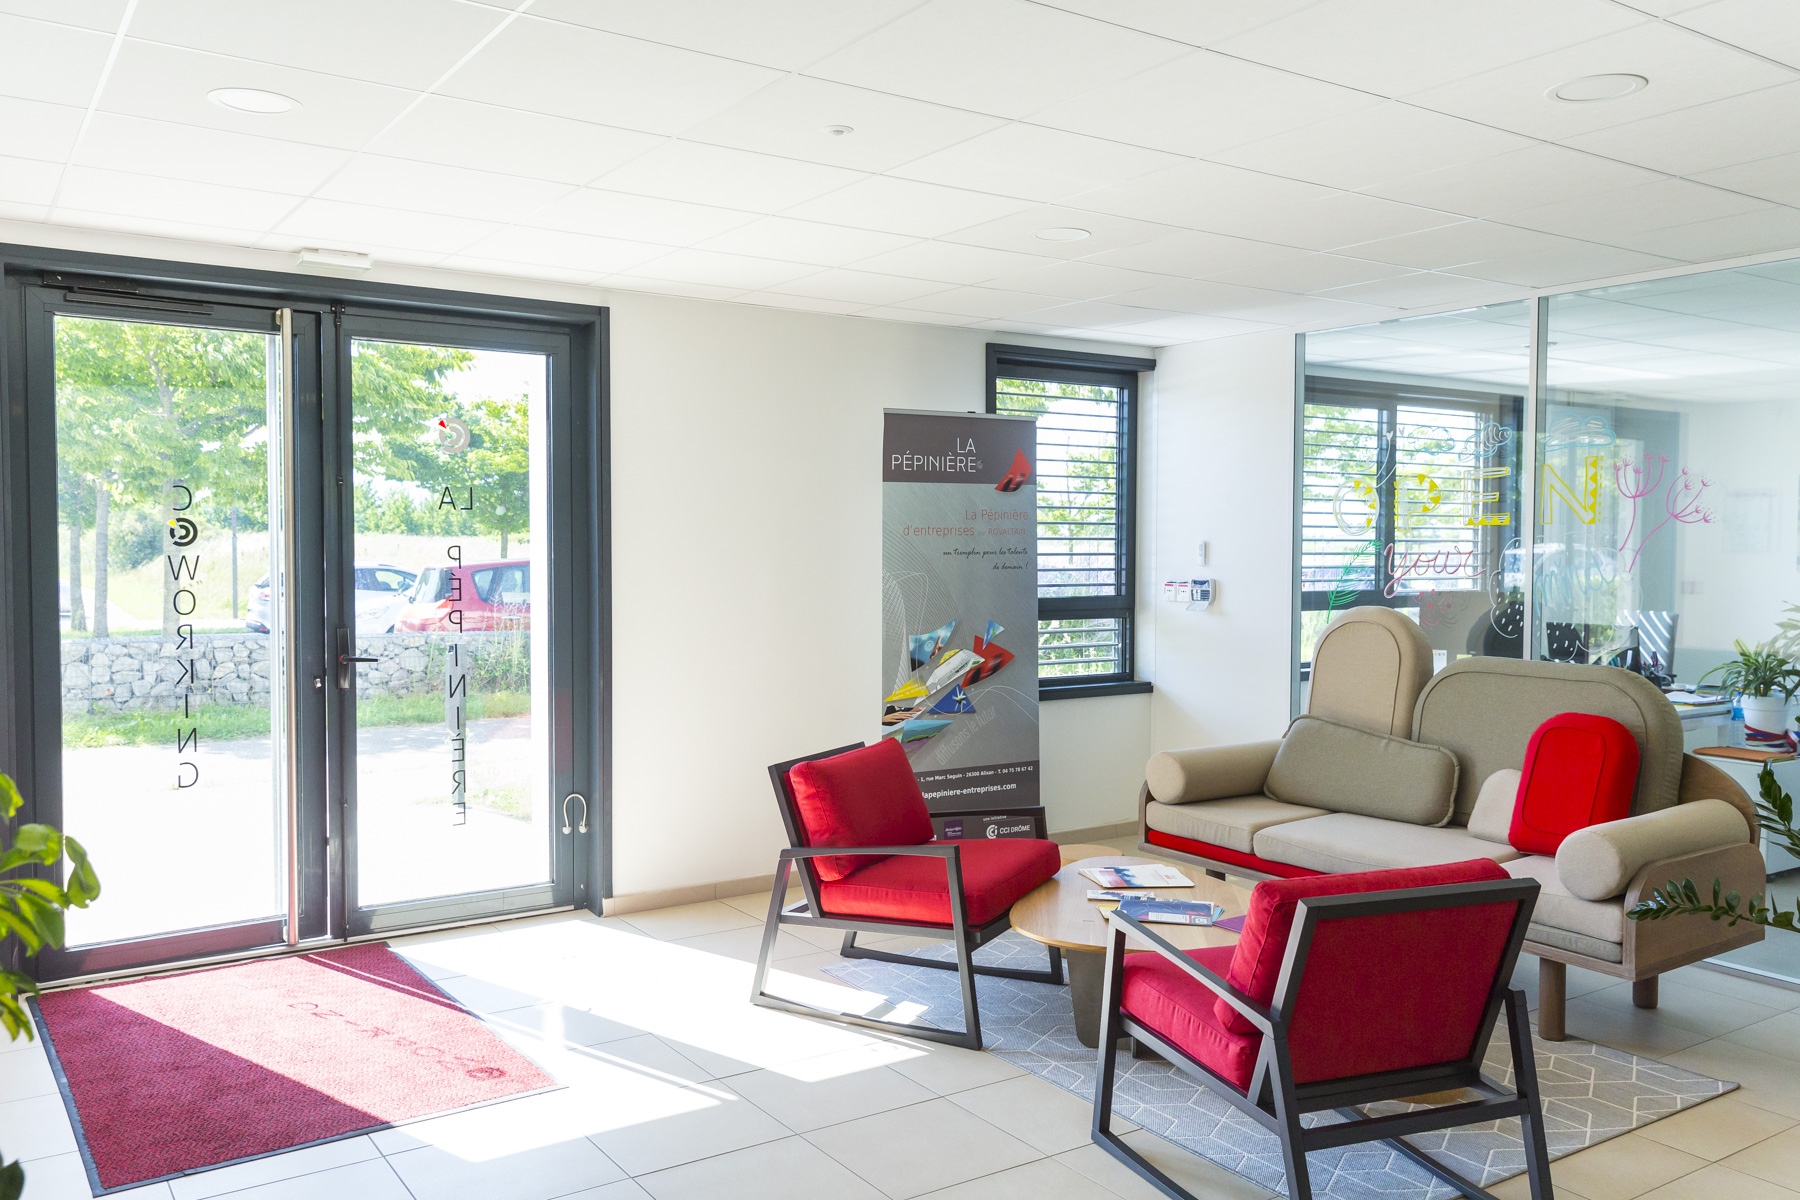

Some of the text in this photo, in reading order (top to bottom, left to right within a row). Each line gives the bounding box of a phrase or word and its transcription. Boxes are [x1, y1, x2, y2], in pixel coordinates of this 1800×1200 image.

[957, 437, 976, 453] LA
[891, 451, 977, 473] PÉPINIÈRE
[1333, 455, 1602, 536] OPEN
[965, 508, 1029, 523] La Pépinière
[903, 525, 975, 538] d'entreprises
[953, 547, 981, 558] tremplin
[982, 550, 997, 558] pour
[1007, 547, 1028, 555] talents
[993, 562, 1000, 570] de
[1001, 562, 1023, 570] demain
[1384, 543, 1486, 598] your
[936, 729, 970, 766] diffusons
[1011, 825, 1030, 833] DRÔME
